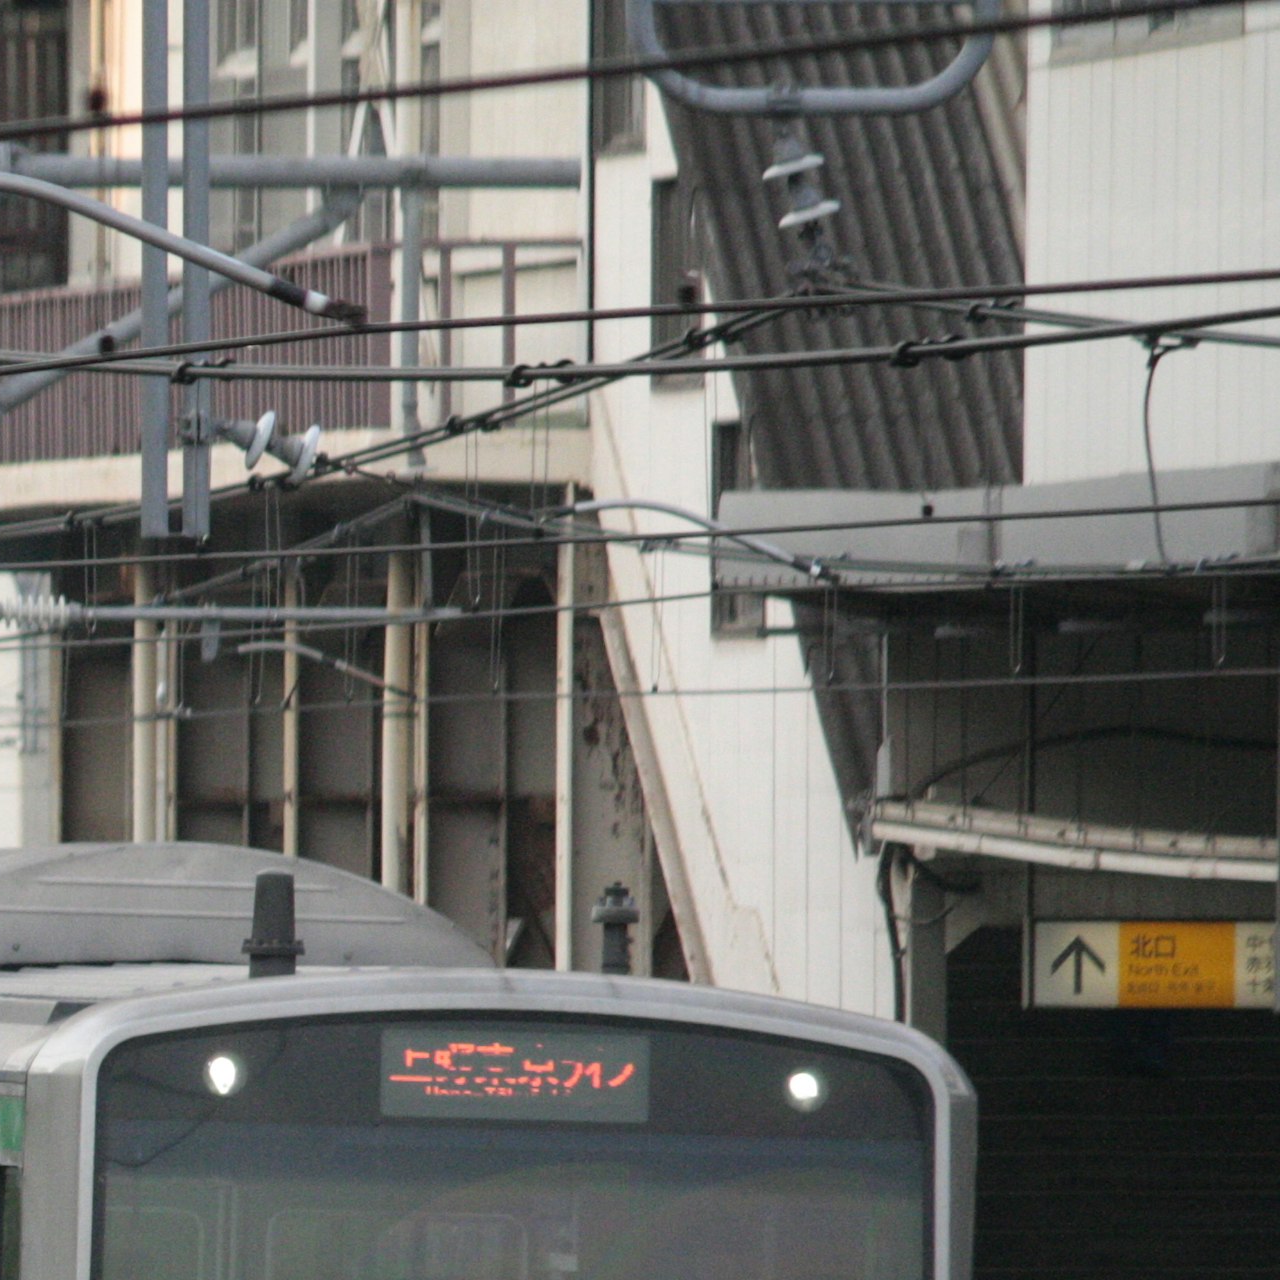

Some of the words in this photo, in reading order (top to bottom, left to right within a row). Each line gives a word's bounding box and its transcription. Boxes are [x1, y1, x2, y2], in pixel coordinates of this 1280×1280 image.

[1130, 934, 1176, 958] 北口
[1128, 963, 1169, 976] North
[1172, 962, 1200, 976] Exit
